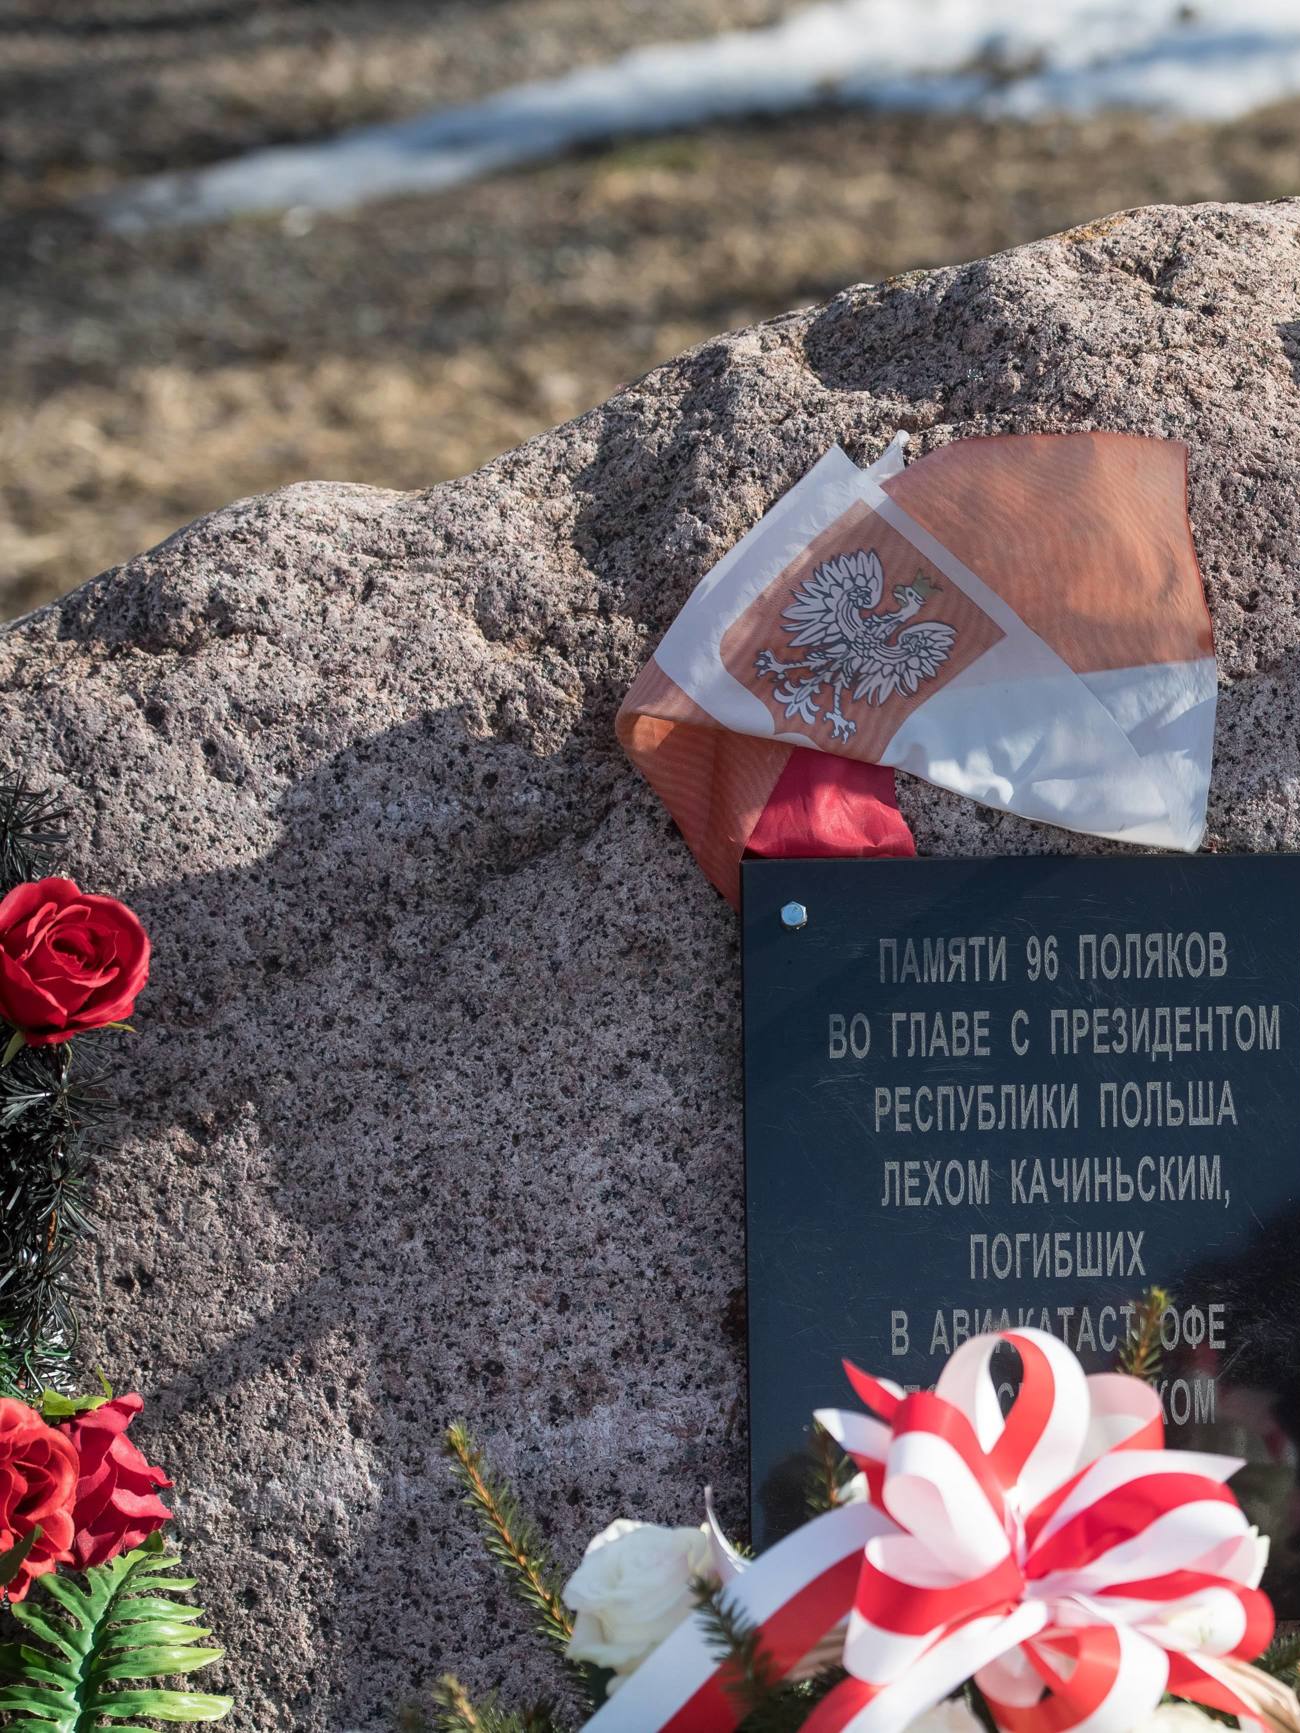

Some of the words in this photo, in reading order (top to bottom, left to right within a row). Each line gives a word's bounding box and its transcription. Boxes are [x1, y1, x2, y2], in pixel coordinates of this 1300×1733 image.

[878, 935, 1007, 984] ПАМЯТИ
[1026, 934, 1059, 982] 96
[1079, 931, 1229, 980] ПОЛЯКОВ
[828, 1012, 872, 1060] ВО
[891, 1010, 991, 1058] ГЛАВЕ
[1010, 1009, 1030, 1056] С
[1050, 1004, 1281, 1062] ПРЕЗИДЕНТОМ
[874, 1082, 1079, 1133] РЕСПУБЛИКИ
[1099, 1080, 1239, 1129] ПОЛЬША
[881, 1159, 991, 1207] ЛЕХОМ
[1010, 1155, 1231, 1209] КАЧИНЬСКИМ,
[969, 1231, 1146, 1279] ПОГИБШИХ
[890, 1309, 911, 1356] В
